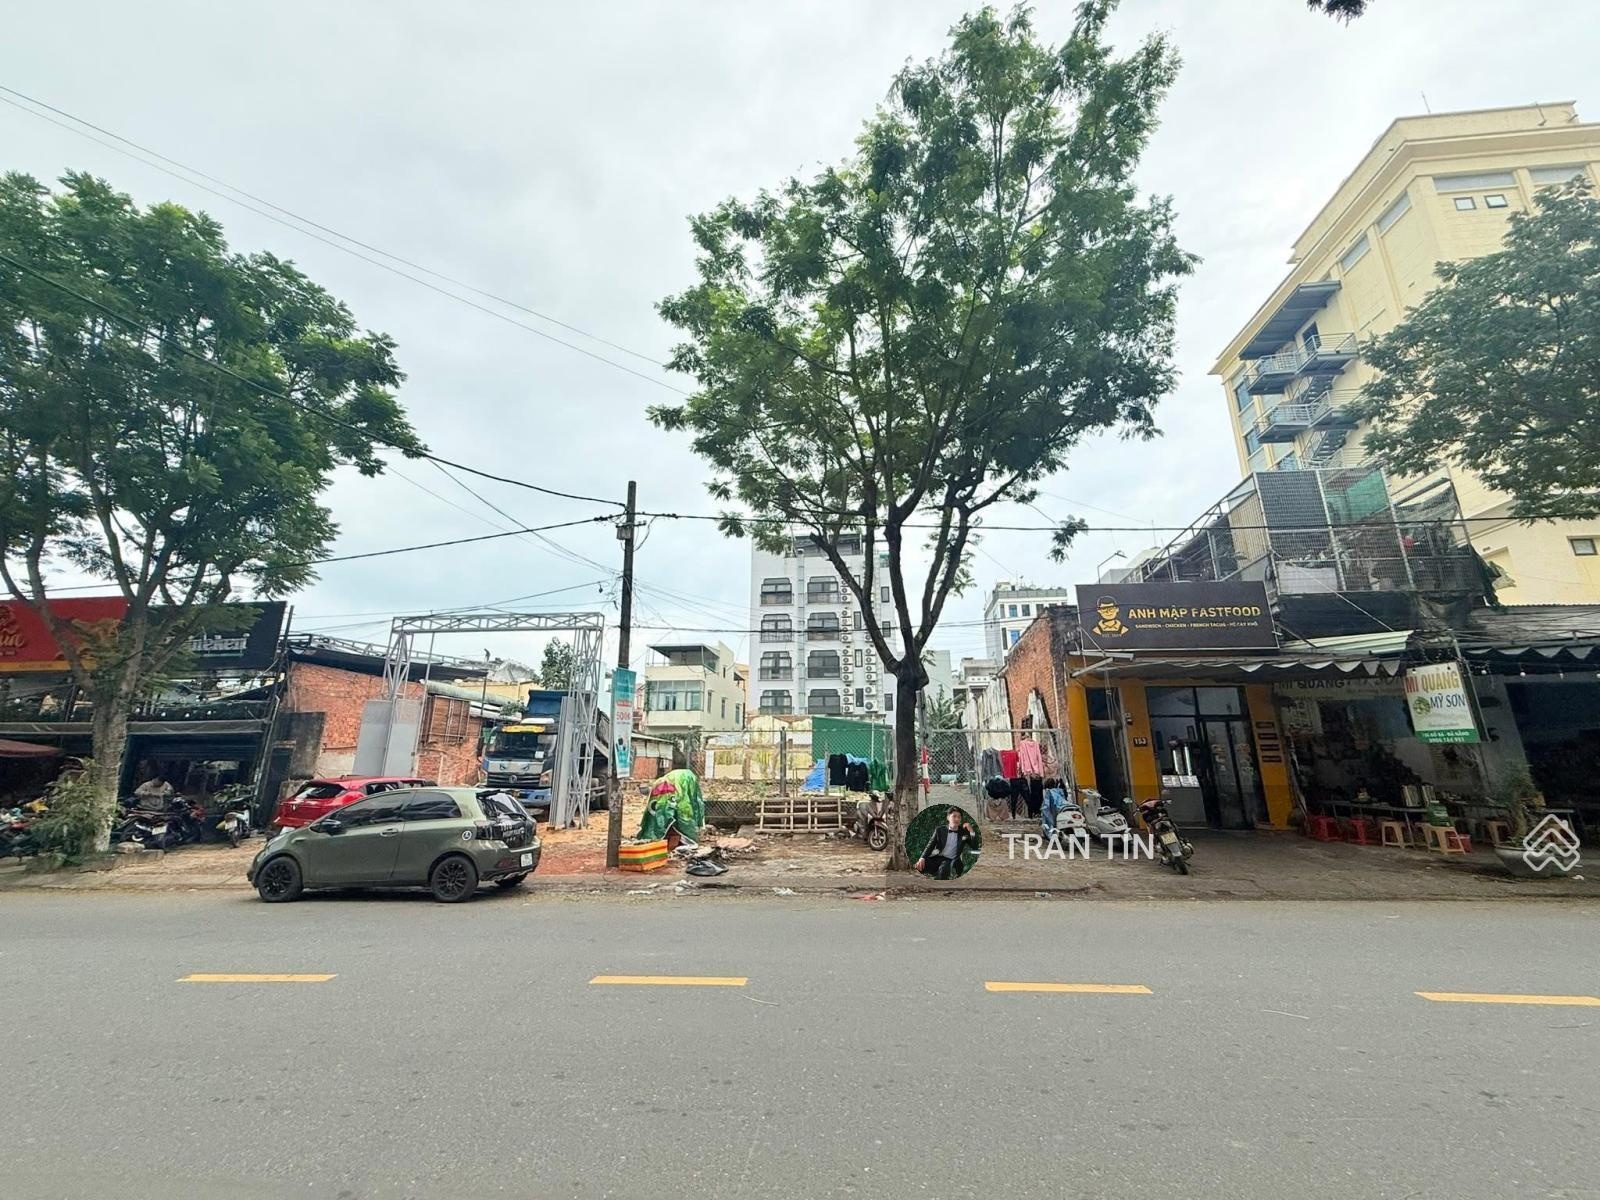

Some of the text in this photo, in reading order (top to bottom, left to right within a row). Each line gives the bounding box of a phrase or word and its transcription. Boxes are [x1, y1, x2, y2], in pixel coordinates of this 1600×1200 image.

[1128, 604, 1262, 620] ANH MẬP FASTFOOD
[1430, 692, 1466, 709] MỸ SƠN
